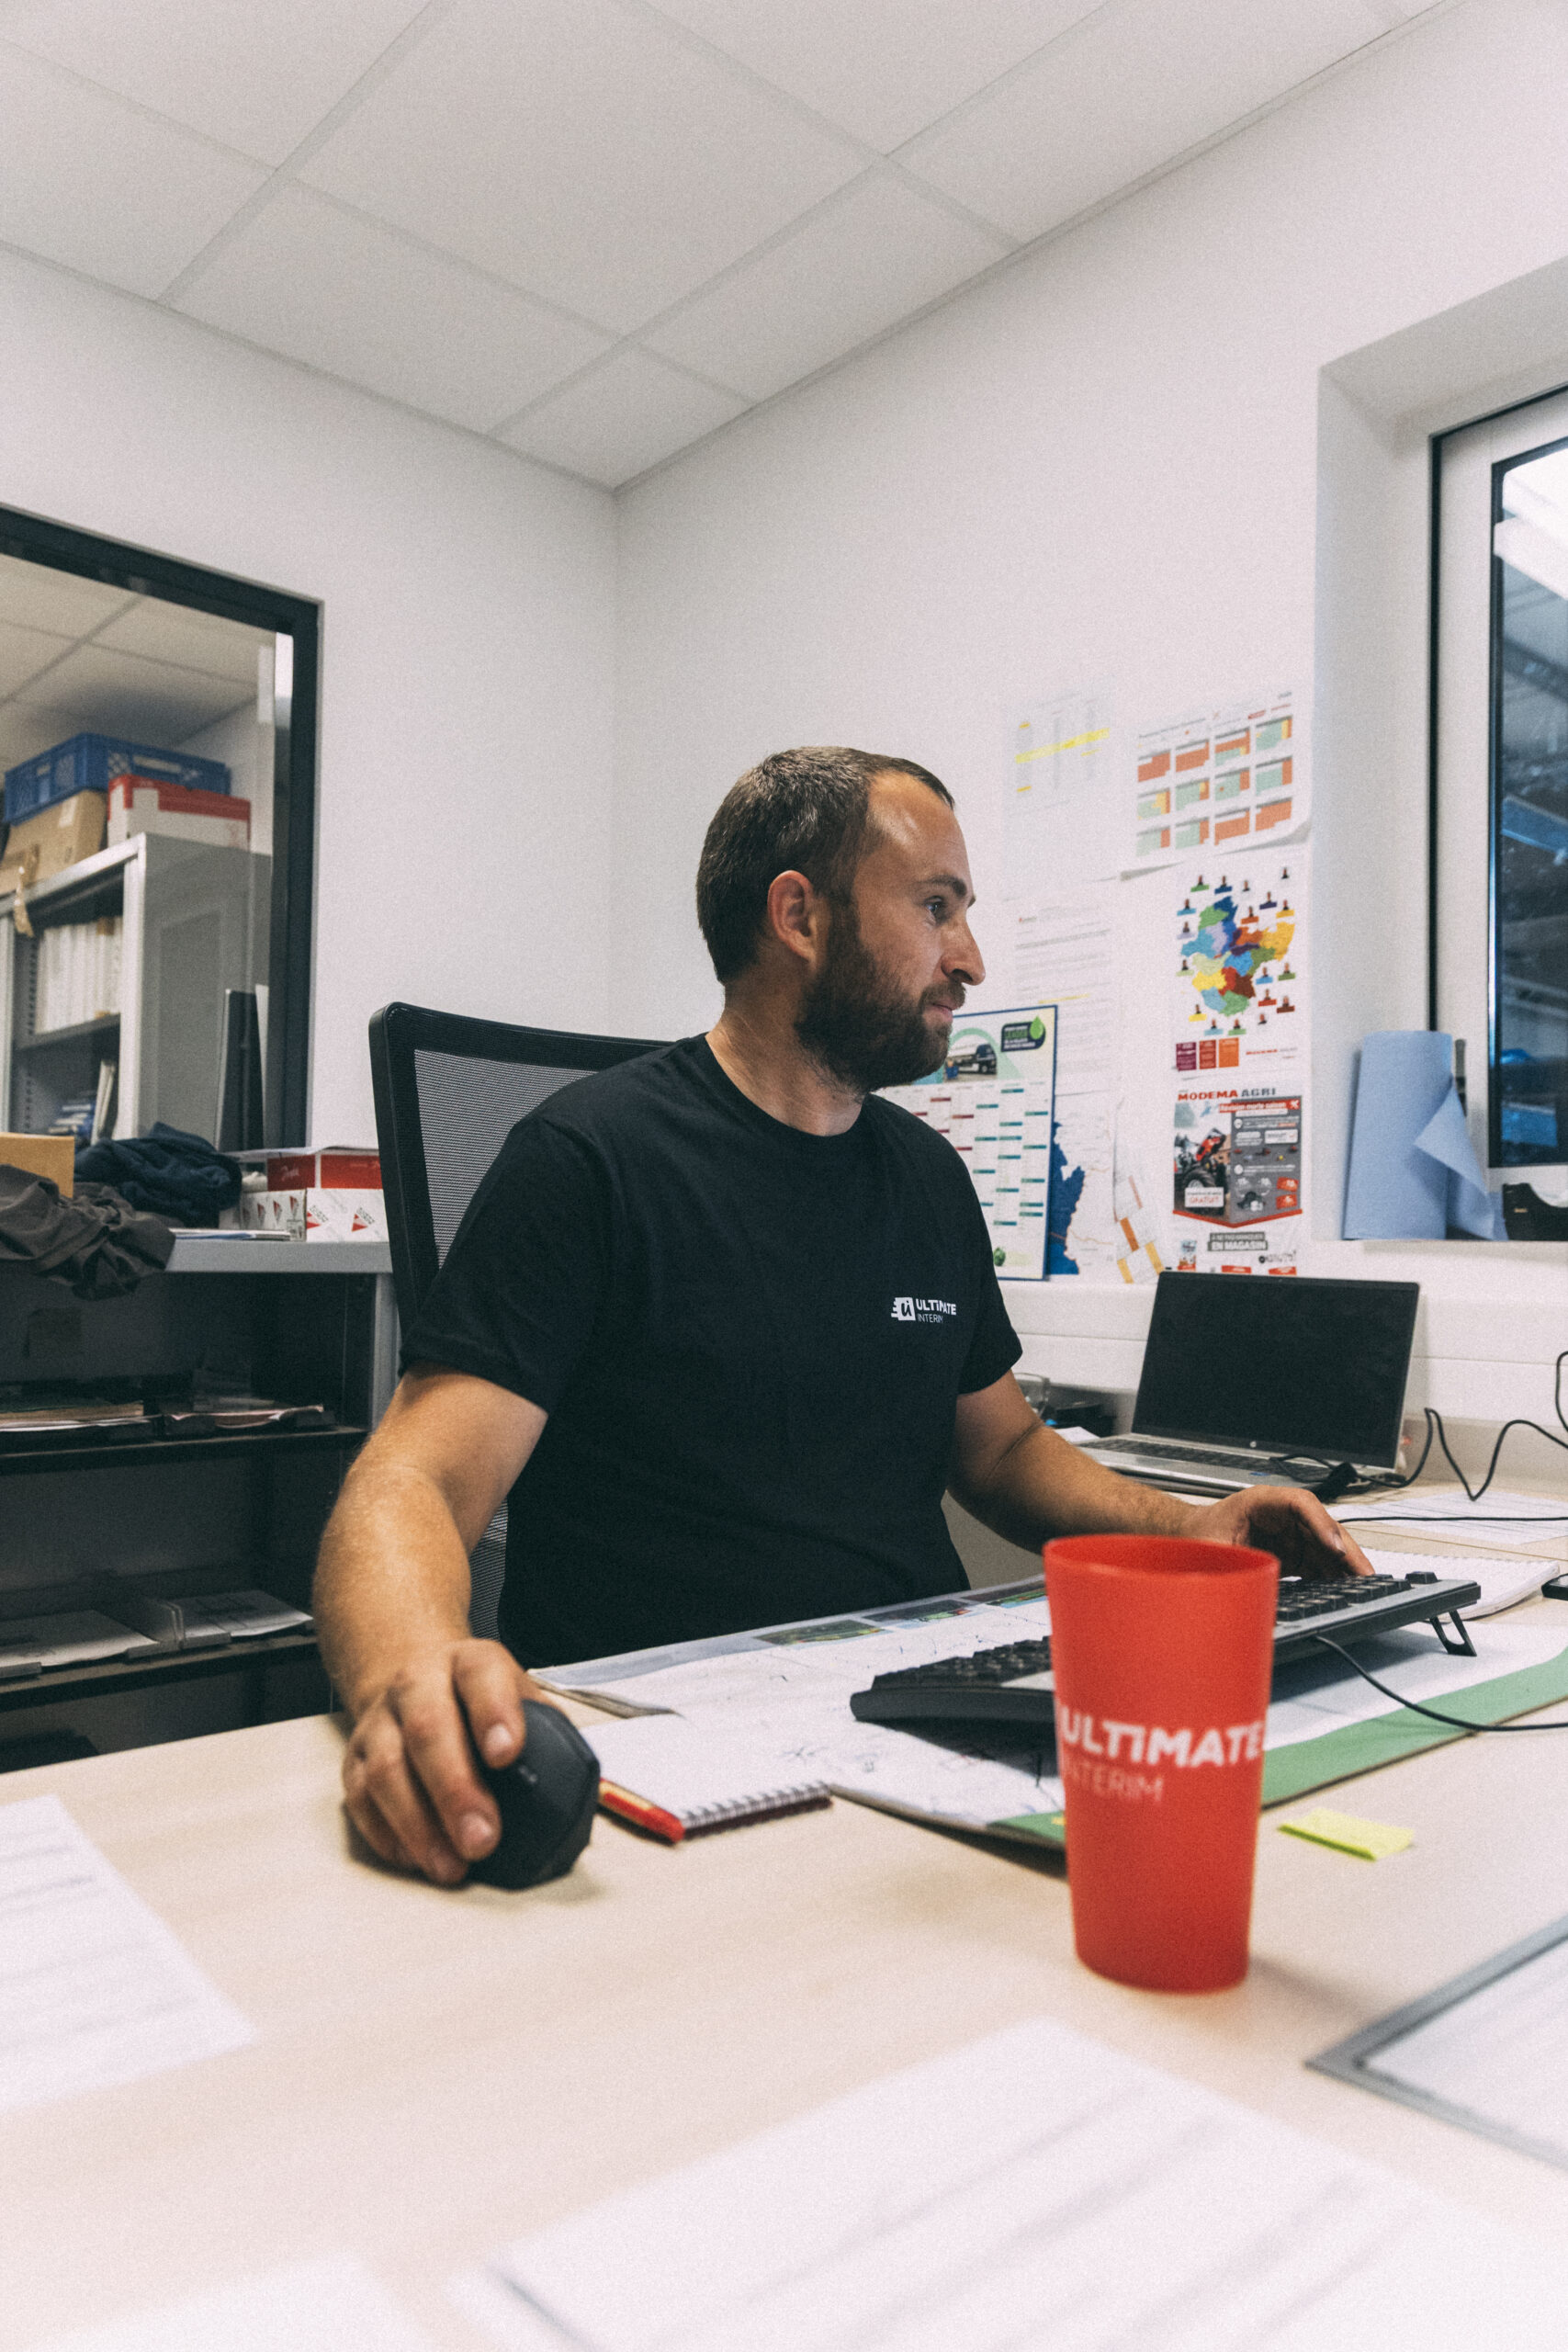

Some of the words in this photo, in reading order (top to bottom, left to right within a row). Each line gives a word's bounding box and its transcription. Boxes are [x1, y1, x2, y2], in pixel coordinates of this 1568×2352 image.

[1178, 1090, 1238, 1102] MODEMA
[1241, 1088, 1277, 1097] AGRI
[1212, 1241, 1224, 1250] EN
[1224, 1240, 1266, 1250] MAGASIN
[916, 1298, 956, 1315] ULTIMATE
[917, 1313, 943, 1324] INTERIM
